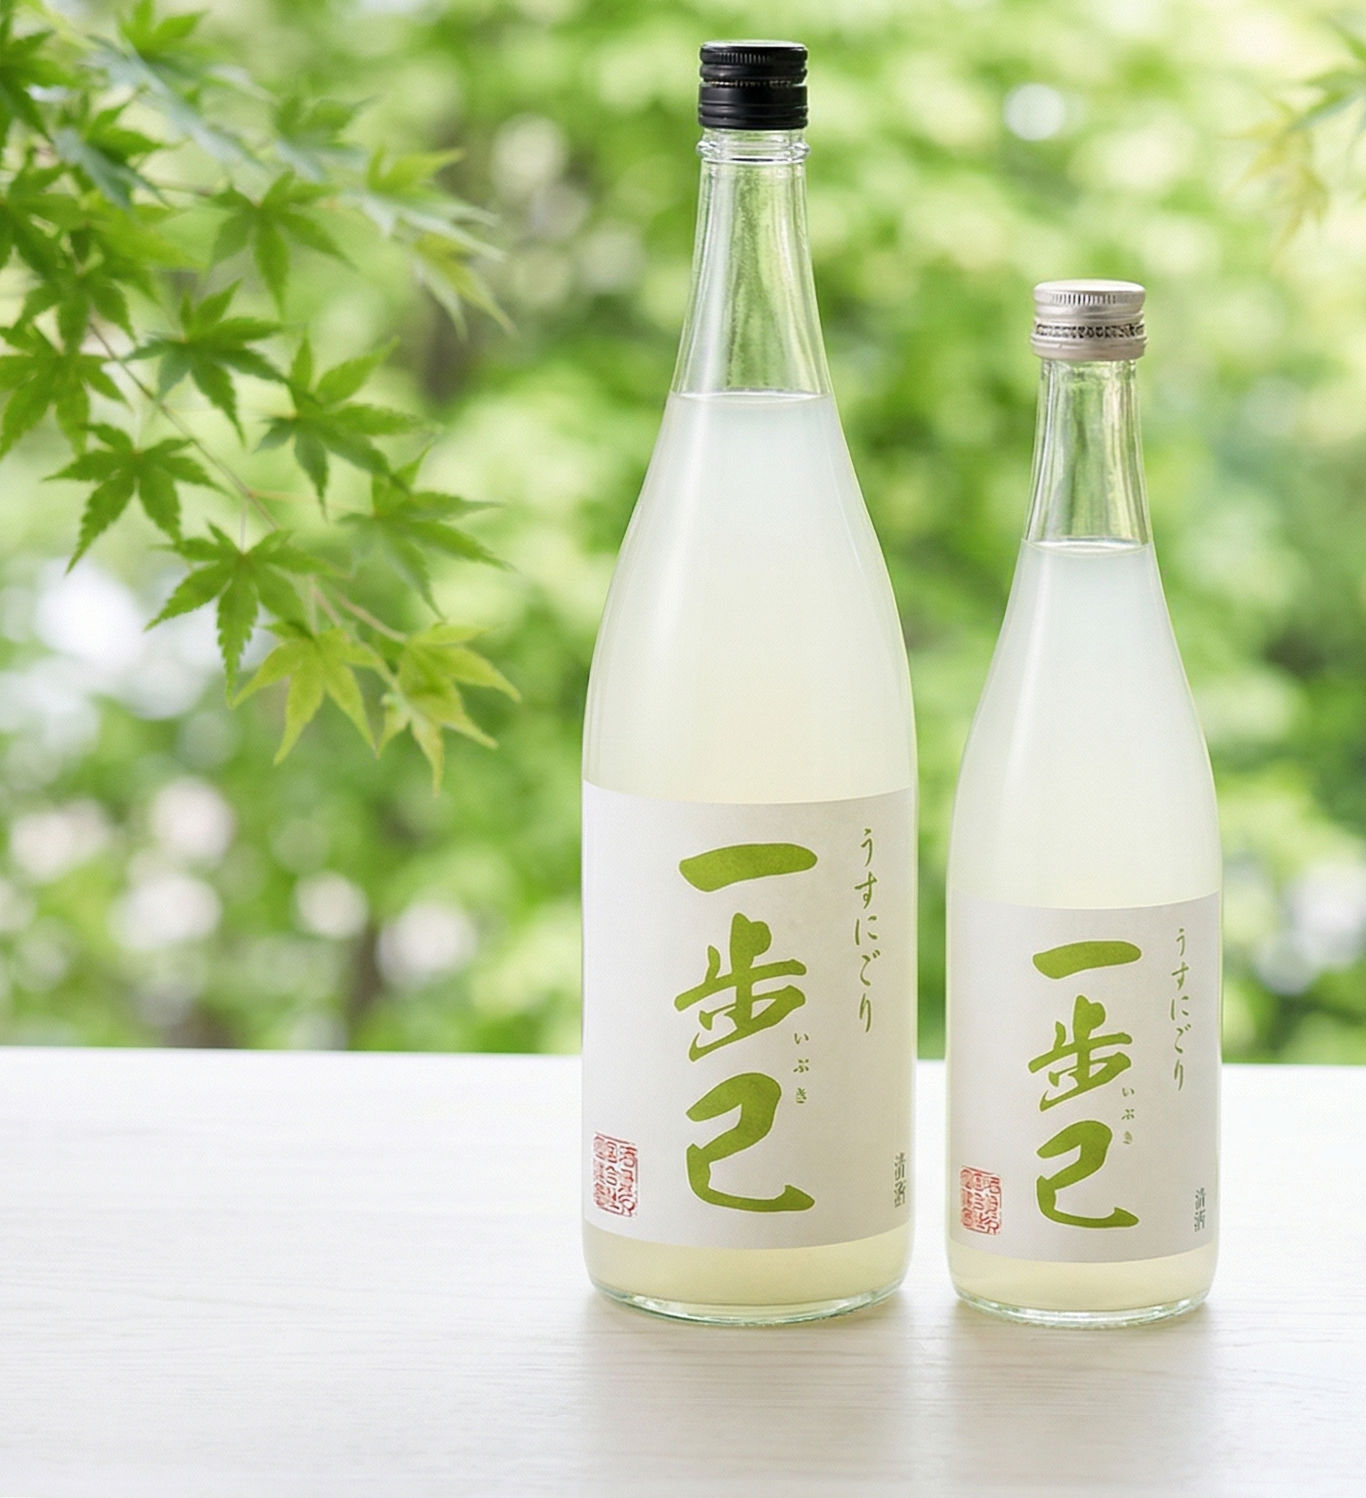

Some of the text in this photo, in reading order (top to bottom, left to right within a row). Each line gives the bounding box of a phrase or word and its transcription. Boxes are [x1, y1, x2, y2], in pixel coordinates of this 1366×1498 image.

[675, 842, 819, 1214] 一歩己
[854, 828, 883, 1034] うすにごり
[1170, 928, 1193, 1092] うすにごり
[1028, 940, 1143, 1230] 一歩己
